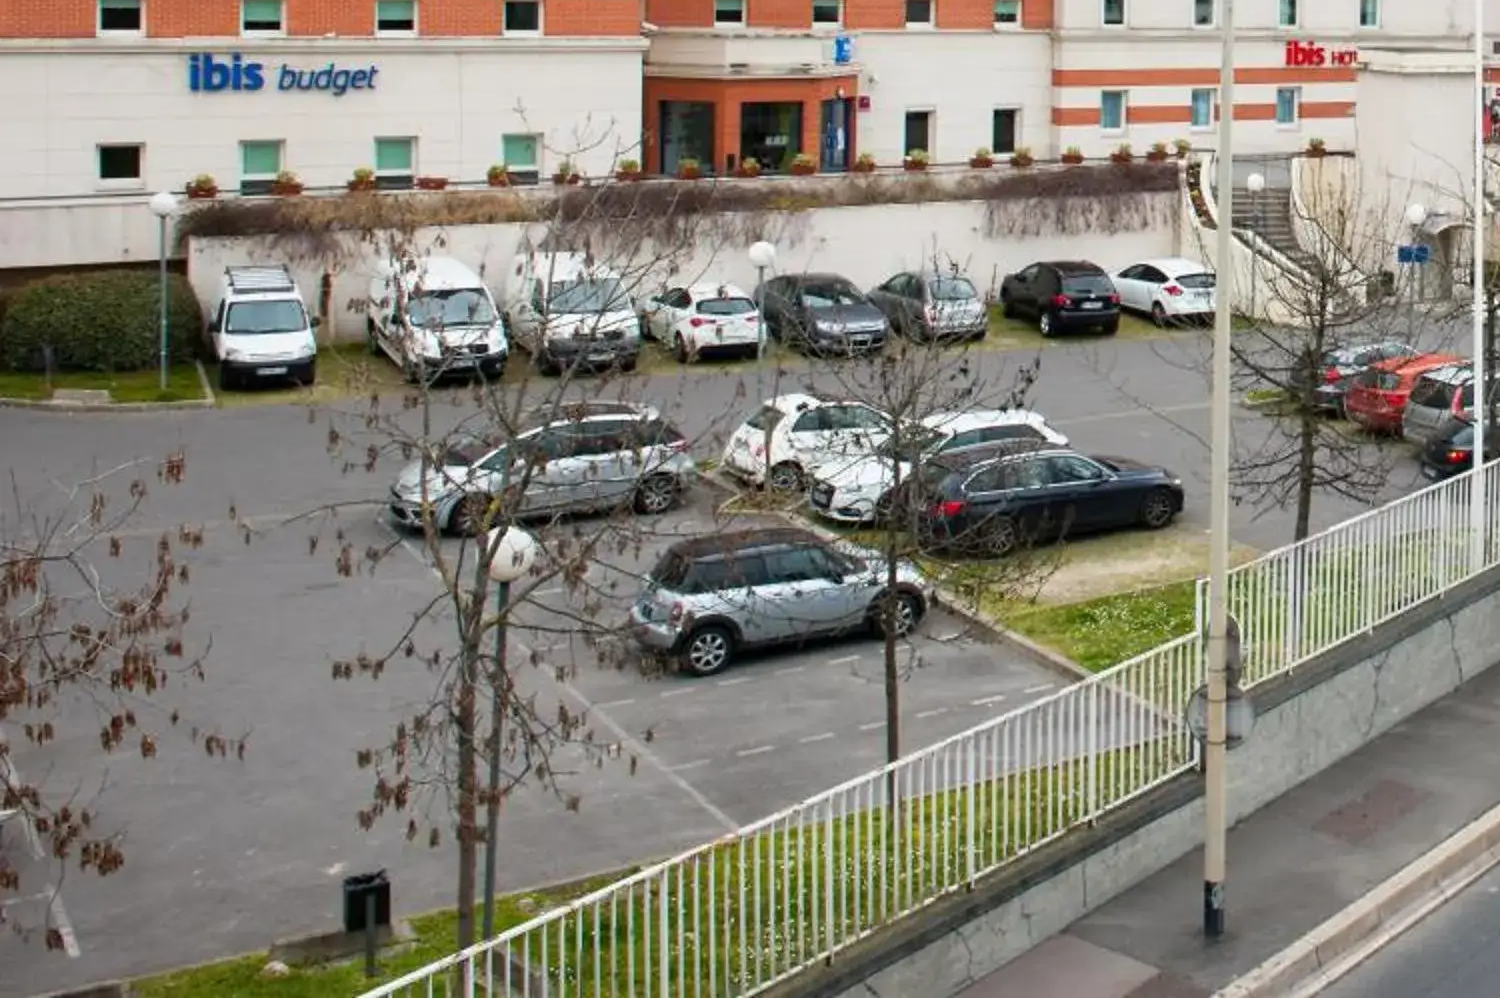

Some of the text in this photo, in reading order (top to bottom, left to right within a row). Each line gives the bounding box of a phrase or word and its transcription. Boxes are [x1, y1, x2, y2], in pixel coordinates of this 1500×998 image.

[1286, 39, 1325, 66] ibis
[189, 52, 378, 96] ibis budget
